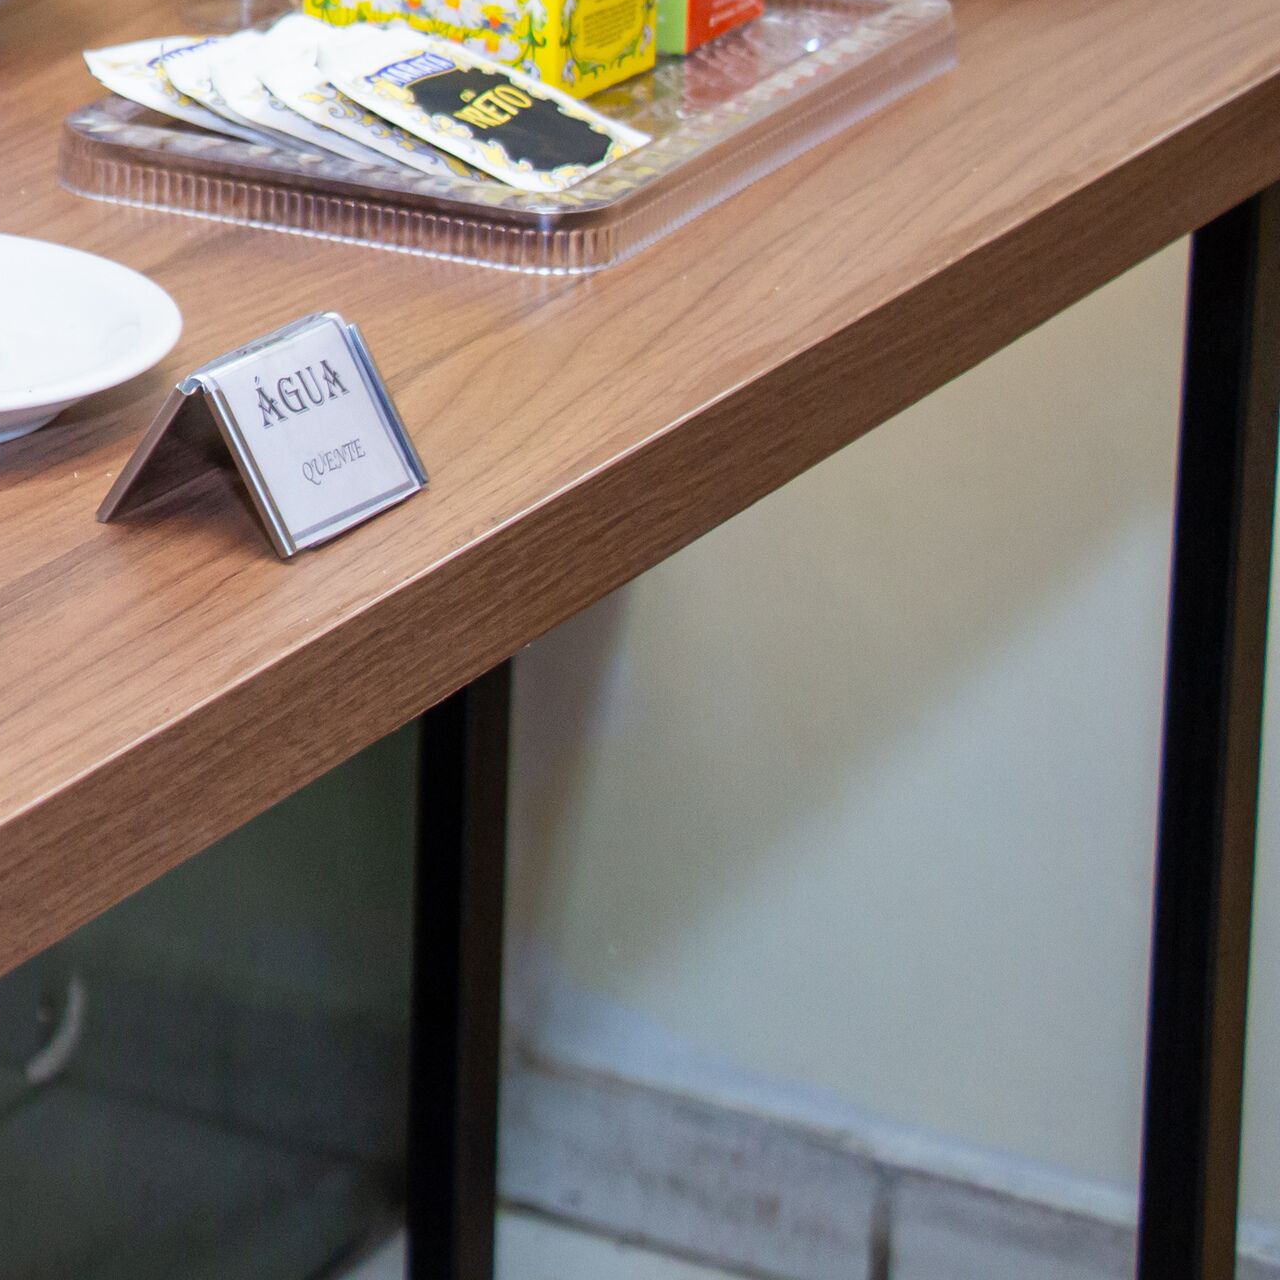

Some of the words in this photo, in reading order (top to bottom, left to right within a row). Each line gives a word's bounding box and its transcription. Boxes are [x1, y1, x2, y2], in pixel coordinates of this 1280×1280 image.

[453, 83, 533, 129] PRETO
[254, 357, 351, 429] ÁGUA
[301, 437, 367, 486] QUENTE
